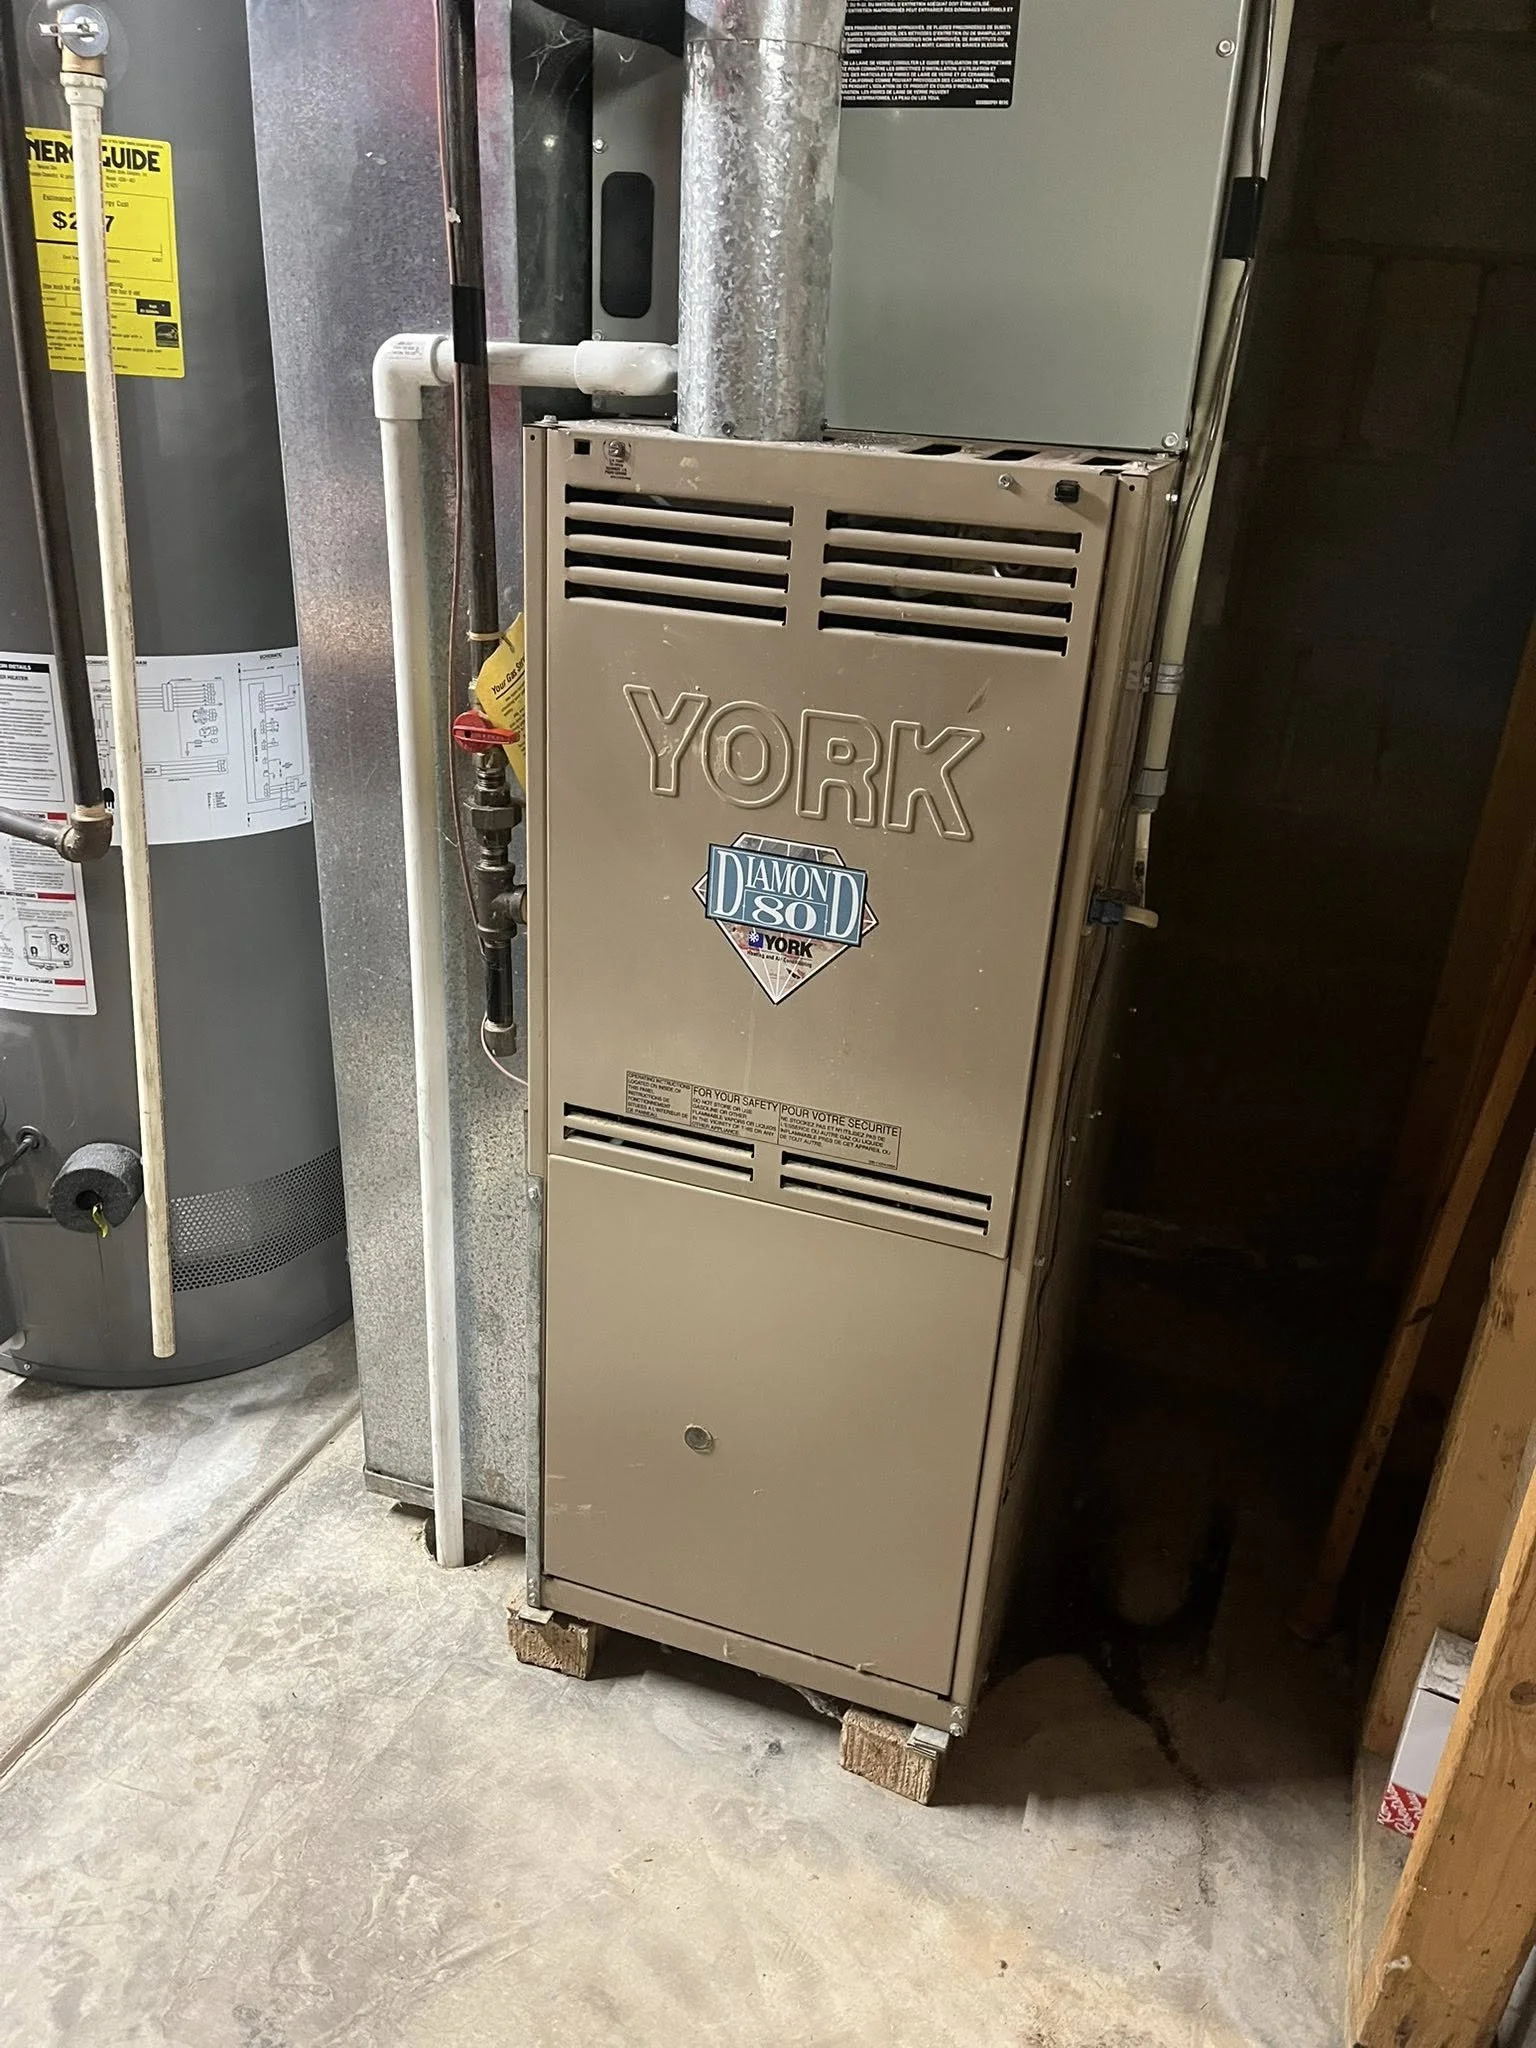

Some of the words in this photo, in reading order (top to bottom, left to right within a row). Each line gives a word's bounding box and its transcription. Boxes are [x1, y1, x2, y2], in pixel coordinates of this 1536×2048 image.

[52, 210, 115, 233] $27
[492, 680, 506, 694] Your
[506, 669, 517, 682] Gas
[623, 684, 985, 842] YORK
[714, 848, 859, 941] DIAMOND
[752, 895, 816, 932] 80
[765, 934, 813, 958] YORK
[693, 1086, 712, 1098] FOR
[714, 1090, 740, 1104] YOUR
[743, 1097, 778, 1112] SAFETY
[693, 1103, 718, 1112] GASOLINE
[781, 1104, 809, 1119] POUR
[812, 1111, 845, 1126] VOTRE
[848, 1118, 898, 1137] SECURITE
[789, 1135, 803, 1143] TOUT
[820, 1130, 838, 1138] AUTRE
[861, 1138, 883, 1148] LIQUIDE
